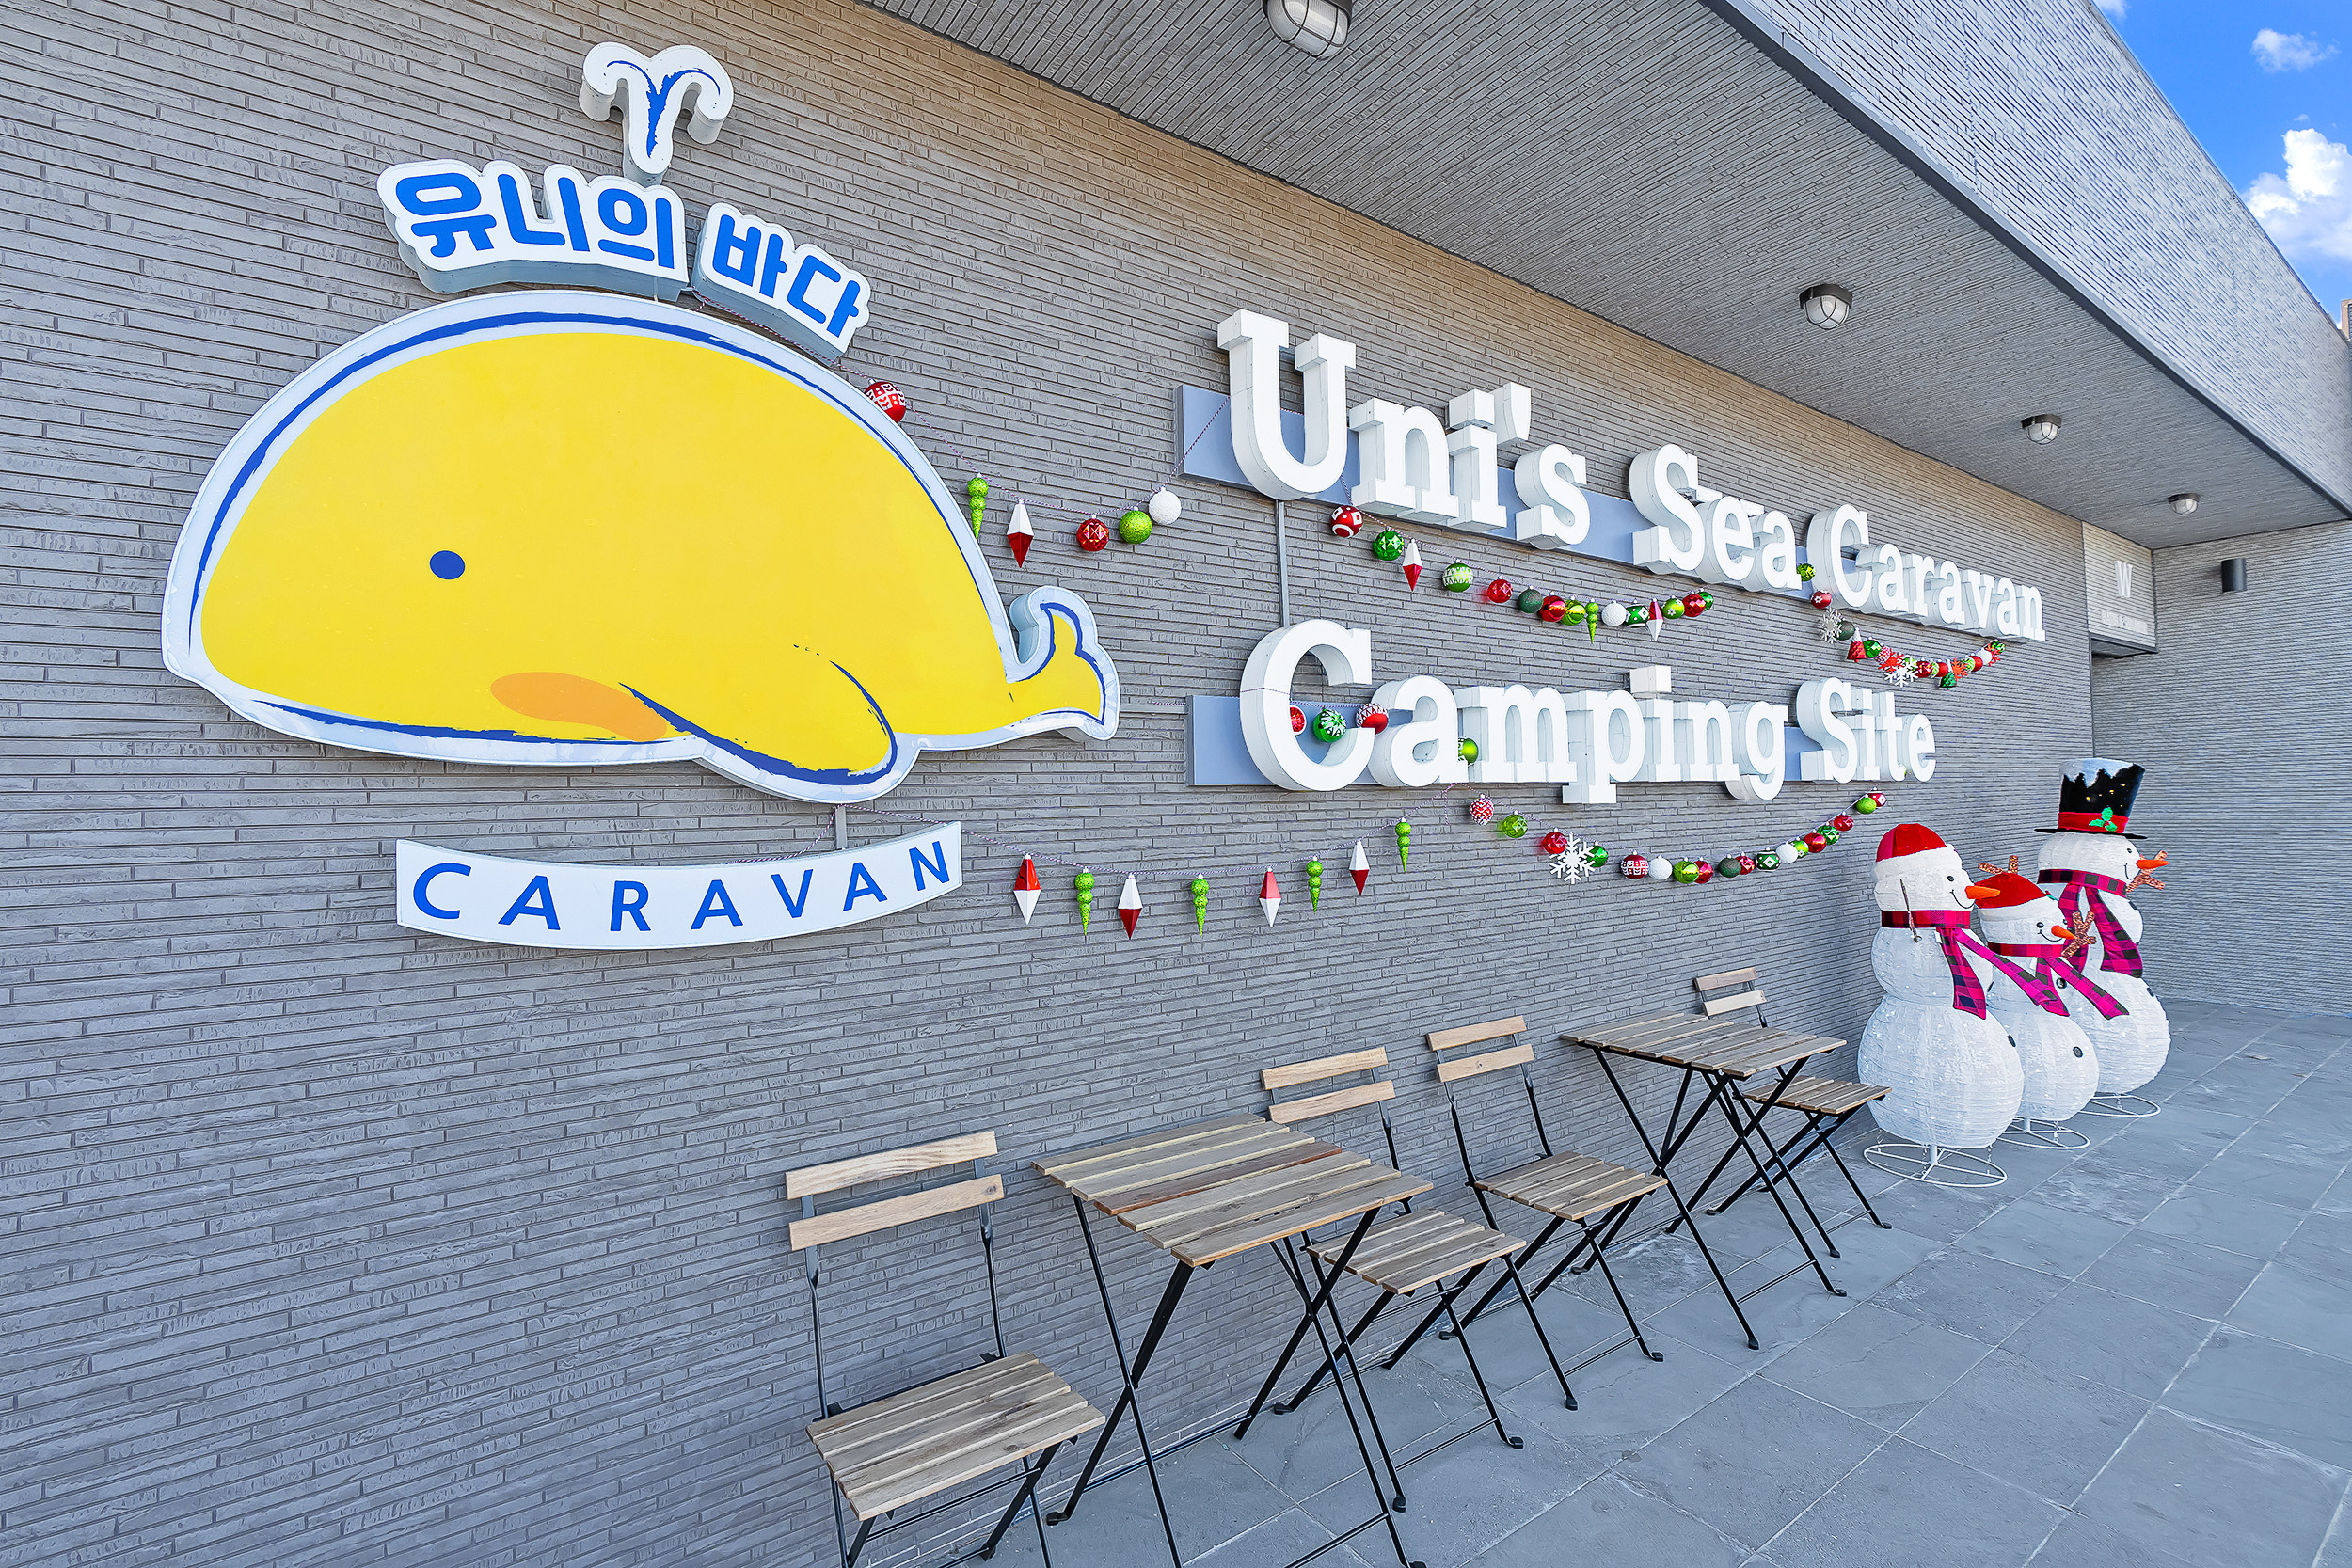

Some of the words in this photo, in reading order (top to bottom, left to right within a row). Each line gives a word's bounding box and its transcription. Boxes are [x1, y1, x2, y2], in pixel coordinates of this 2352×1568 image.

[395, 171, 675, 270] 유니의
[712, 214, 861, 338] 바다
[1217, 309, 1591, 550] Uni's
[1629, 444, 1802, 594] Sea
[1806, 504, 2046, 642] Caravan
[1240, 619, 1788, 804] Camping
[1795, 676, 1936, 784] Site
[412, 840, 952, 932] CARAVAN
